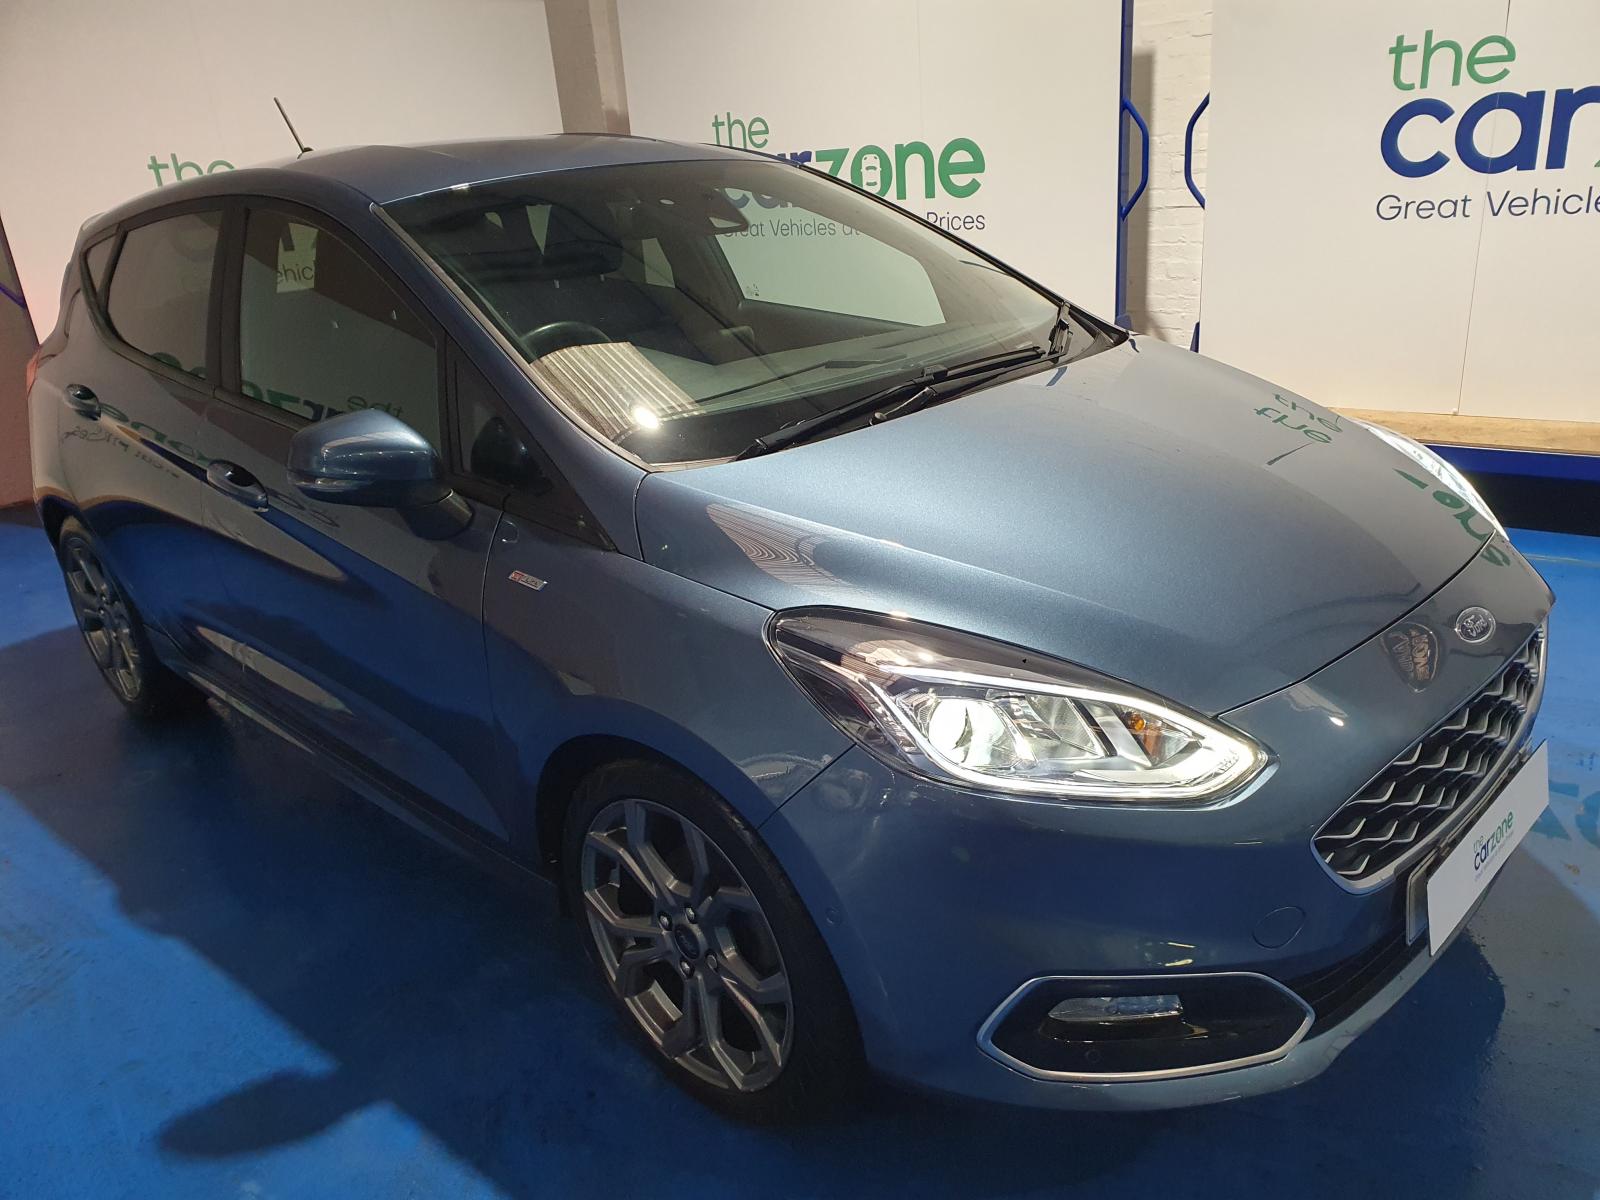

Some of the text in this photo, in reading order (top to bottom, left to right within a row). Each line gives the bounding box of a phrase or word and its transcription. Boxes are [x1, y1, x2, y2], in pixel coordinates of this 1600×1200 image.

[1388, 29, 1517, 91] the
[712, 112, 769, 148] the
[1380, 86, 1600, 178] car
[775, 137, 986, 201] zone
[769, 217, 837, 237] Vehicles
[926, 211, 986, 231] Prices
[1376, 186, 1600, 221] Great Vehicl
[1474, 811, 1514, 871] carzone
